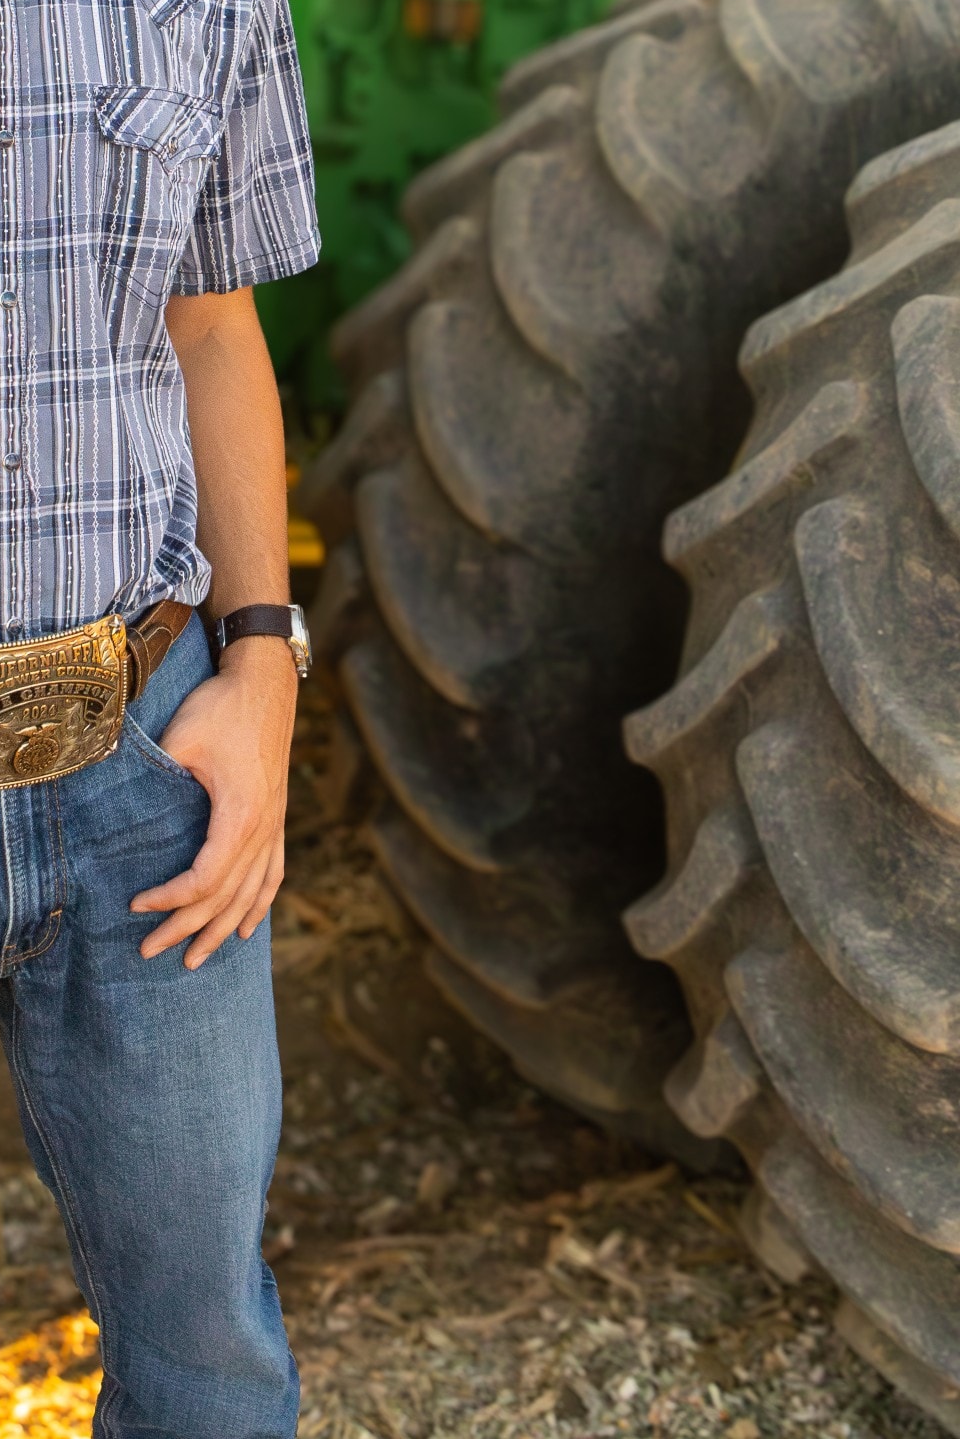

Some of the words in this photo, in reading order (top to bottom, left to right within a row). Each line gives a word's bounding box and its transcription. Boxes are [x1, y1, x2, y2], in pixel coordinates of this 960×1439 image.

[72, 639, 101, 664] FFA
[57, 665, 119, 682] CONTEST
[21, 683, 114, 700] CHAMPION
[22, 704, 58, 720] 2024
